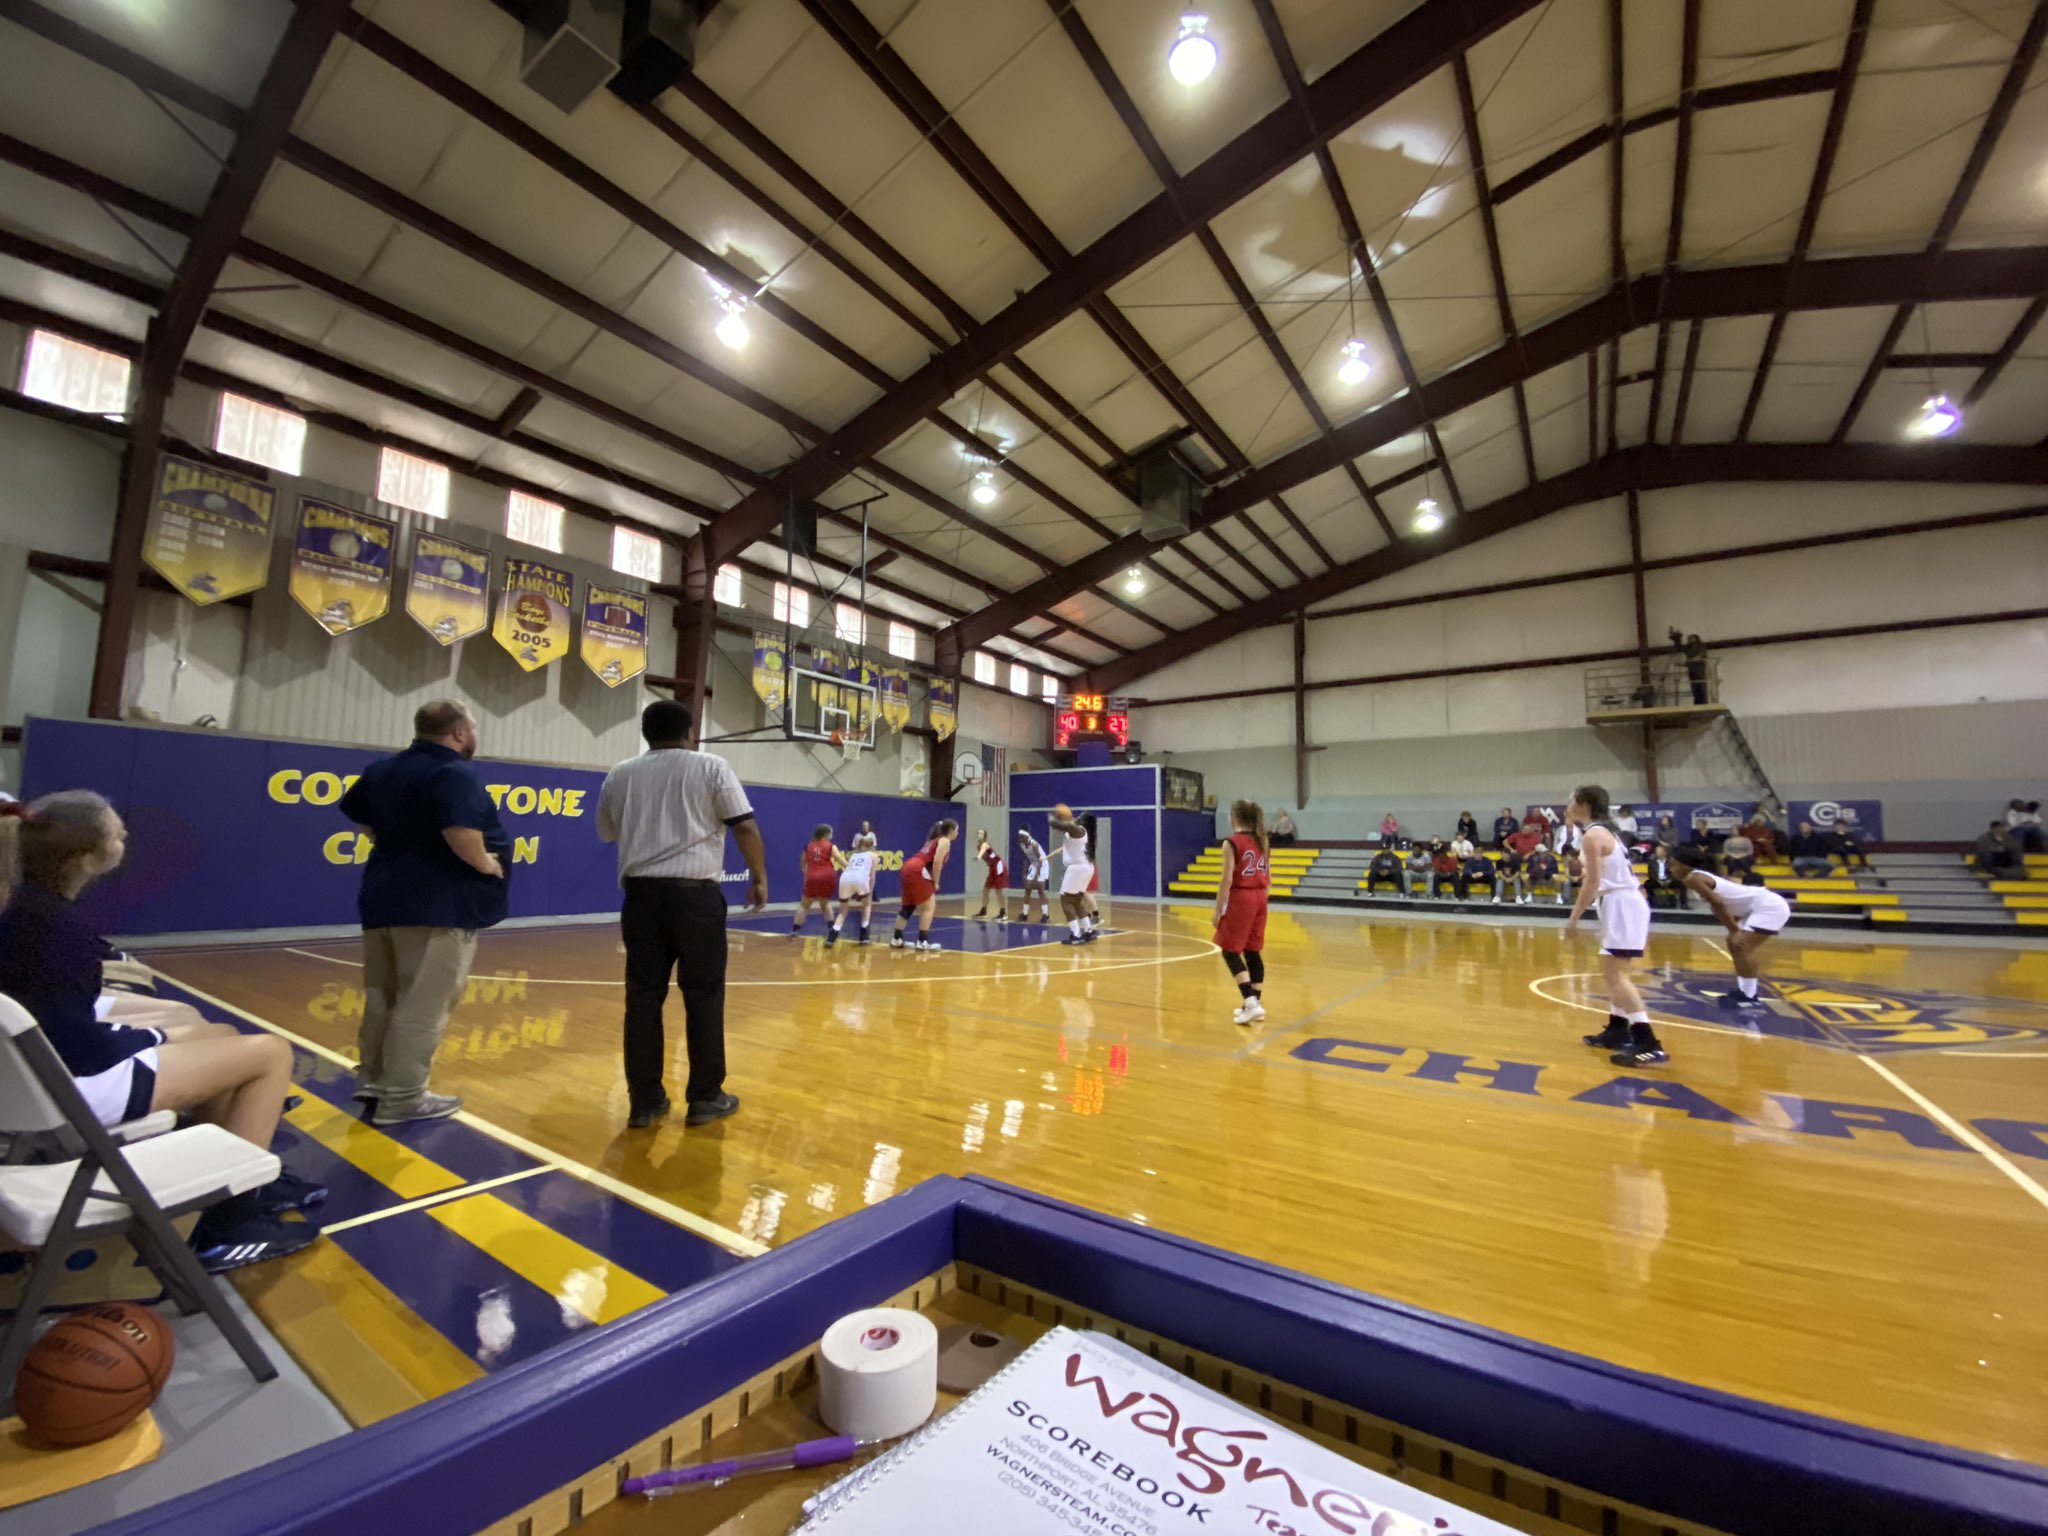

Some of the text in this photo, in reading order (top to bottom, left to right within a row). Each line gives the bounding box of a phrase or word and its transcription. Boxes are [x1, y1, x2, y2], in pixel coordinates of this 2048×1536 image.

[506, 561, 567, 583] STATE
[501, 573, 571, 608] HAMPIONS
[511, 629, 552, 649] 2005
[1074, 695, 1103, 711] 24.6
[1060, 716, 1128, 732] 40 3 27
[1241, 849, 1268, 877] 24
[1006, 1400, 1213, 1524] SCOREBOOK
[1020, 1434, 1157, 1518] 406 BRIDGE AVENUE
[997, 1470, 1037, 1499] (205)
[1081, 1489, 1101, 1506] AL
[1105, 1502, 1159, 1536] 35476
